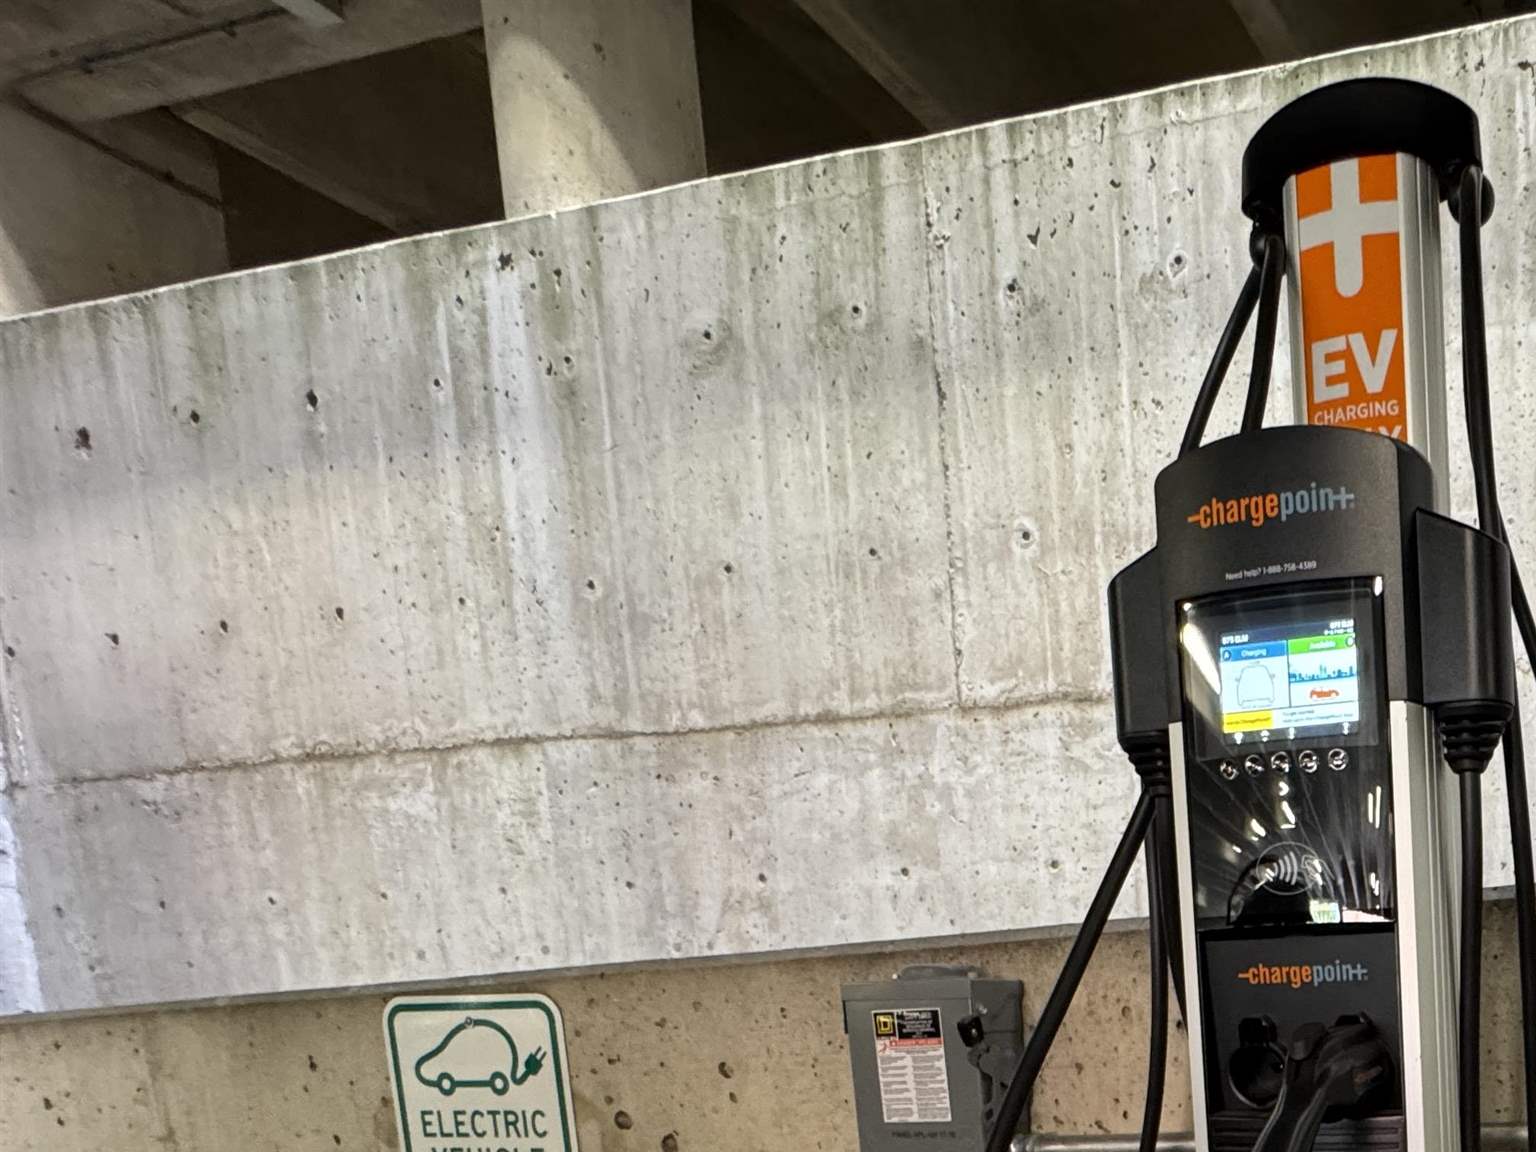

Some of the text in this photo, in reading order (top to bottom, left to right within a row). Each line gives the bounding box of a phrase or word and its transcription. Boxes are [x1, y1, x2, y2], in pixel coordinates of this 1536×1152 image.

[1311, 328, 1398, 404] EV
[1314, 399, 1399, 426] CHARGING
[420, 1109, 548, 1138] ELECTRIC
